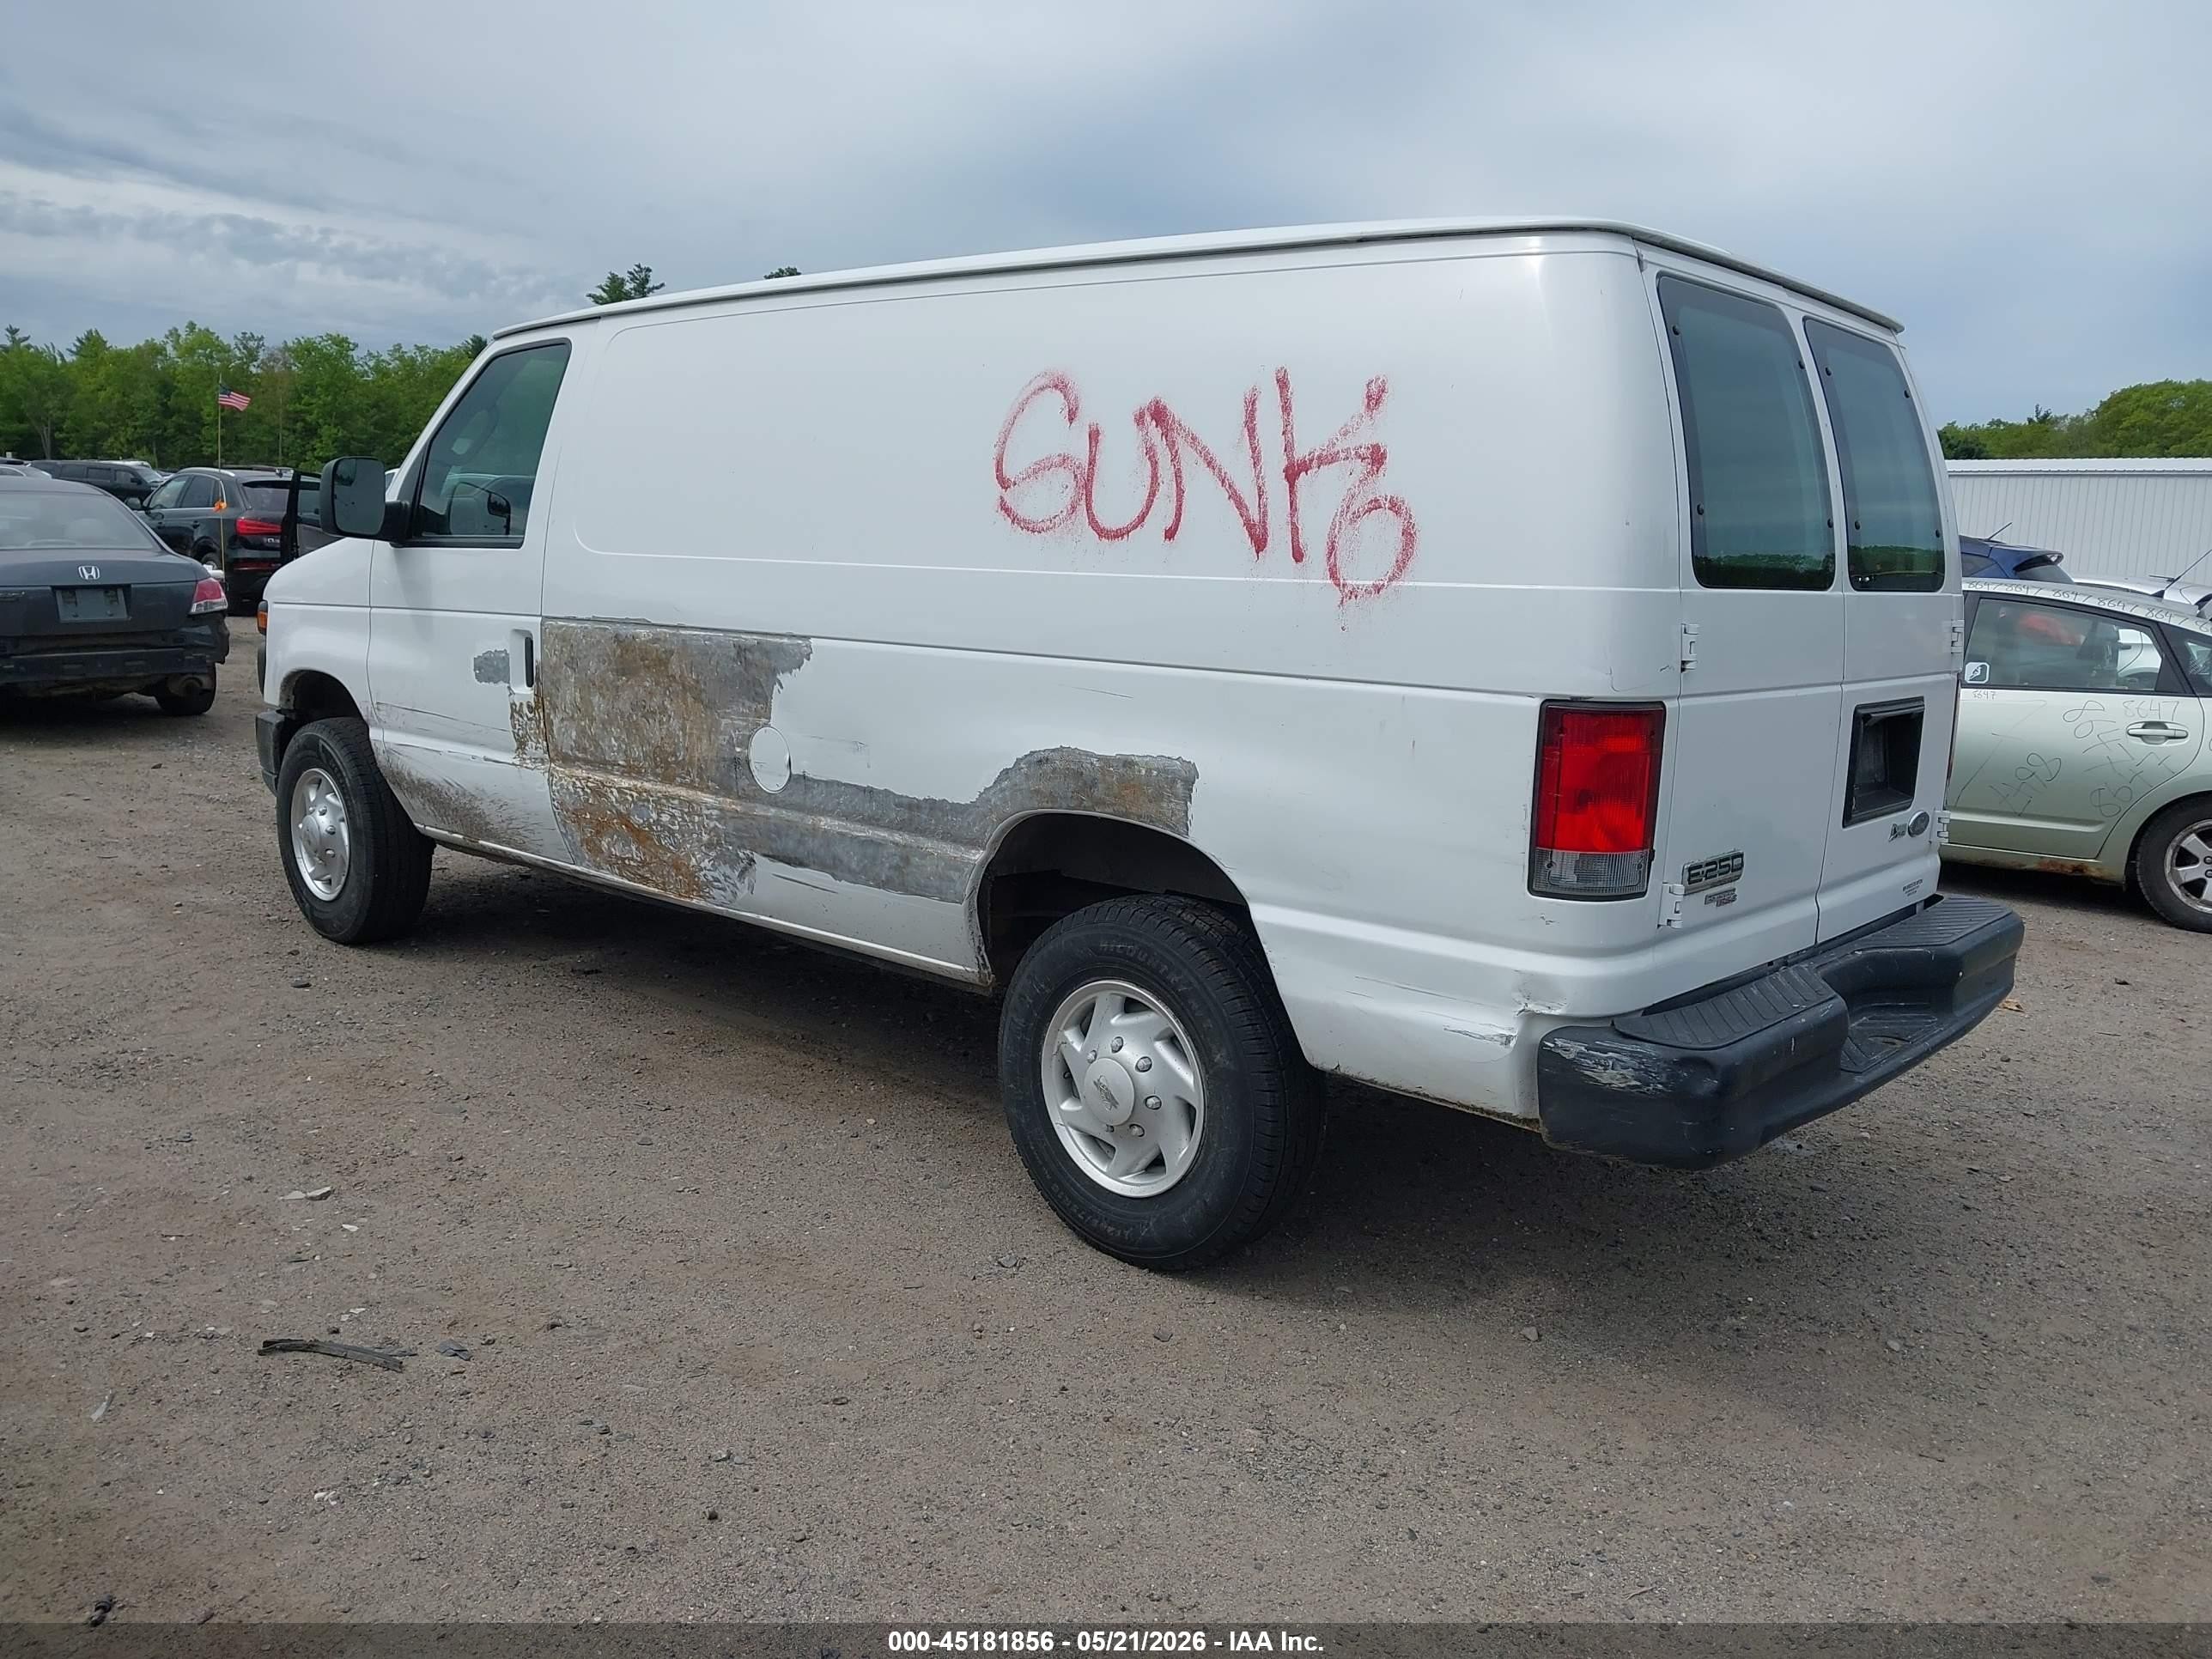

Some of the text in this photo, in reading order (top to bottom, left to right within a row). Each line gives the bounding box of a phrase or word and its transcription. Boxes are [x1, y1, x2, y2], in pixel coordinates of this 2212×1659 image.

[2051, 589, 2094, 603] 8647
[2097, 596, 2140, 613] 8647
[2122, 699, 2179, 722] 8647
